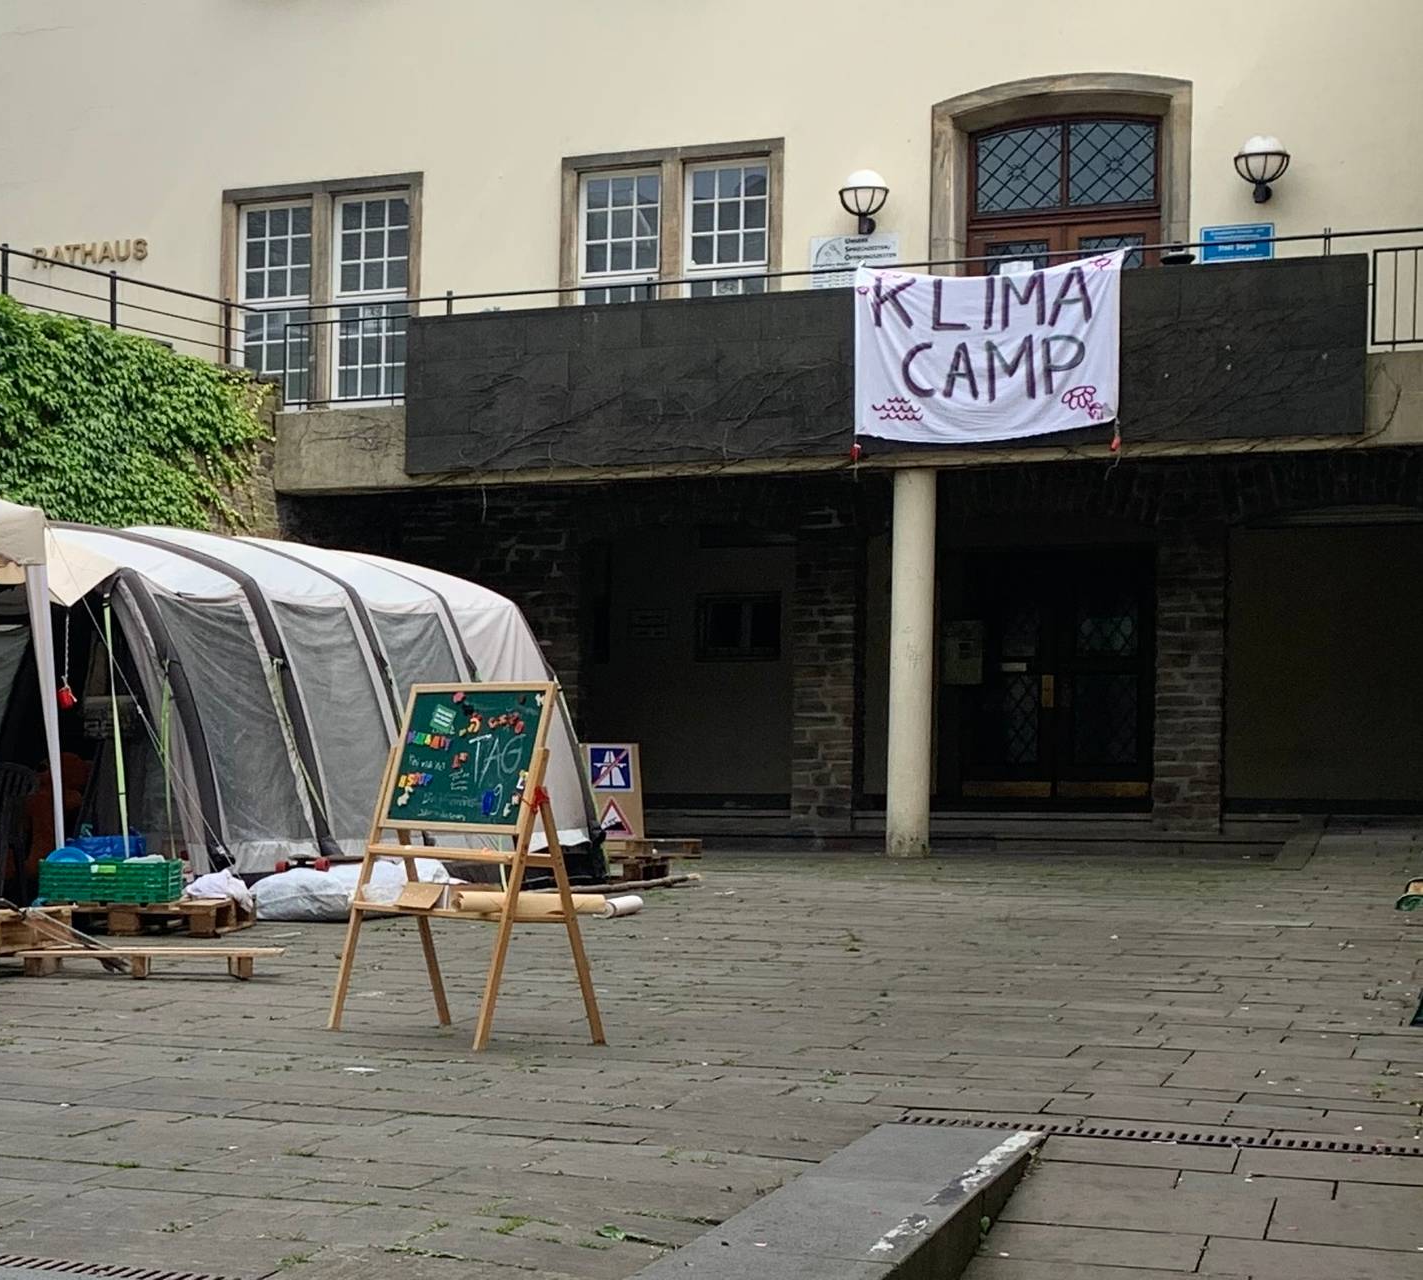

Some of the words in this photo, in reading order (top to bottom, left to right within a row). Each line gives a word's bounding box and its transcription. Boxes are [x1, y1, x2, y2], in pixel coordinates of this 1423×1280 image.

[31, 237, 149, 270] RATHAUS
[871, 266, 1094, 331] KLIMA
[901, 334, 1086, 402] CAMP
[468, 733, 527, 788] TAG
